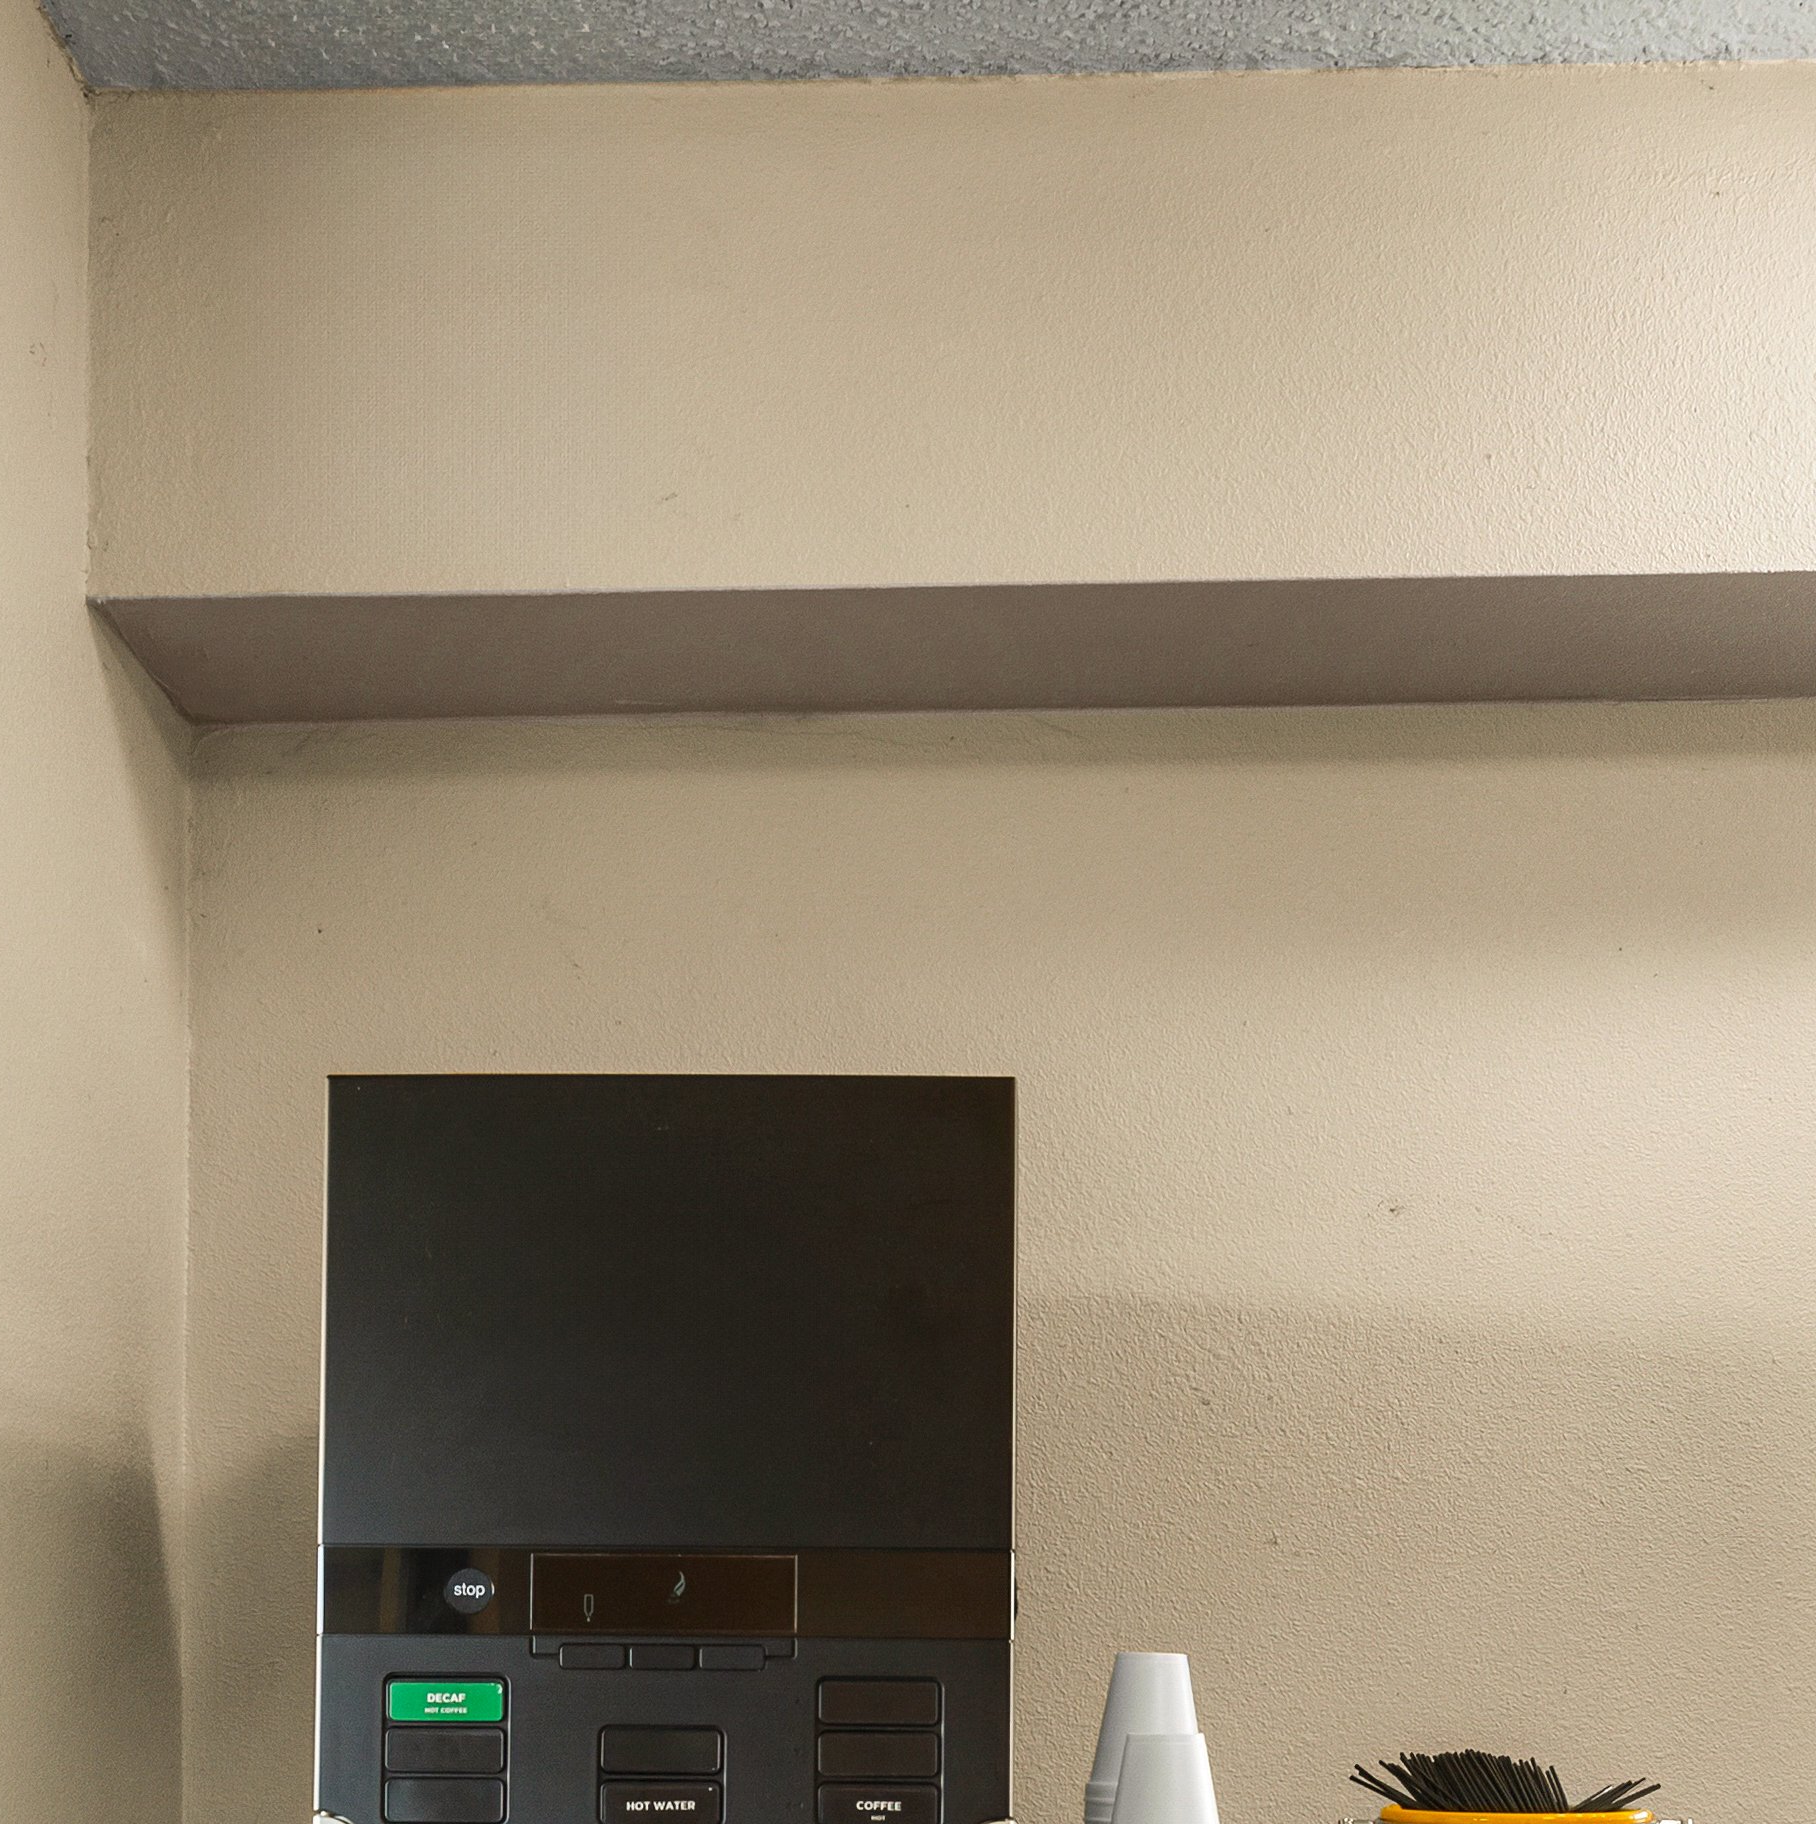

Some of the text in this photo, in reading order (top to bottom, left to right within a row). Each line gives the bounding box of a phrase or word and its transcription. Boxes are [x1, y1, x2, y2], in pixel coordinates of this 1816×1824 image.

[454, 1582, 486, 1599] stop
[426, 1692, 466, 1703] DECAF
[440, 1706, 468, 1714] COFFEE
[626, 1801, 696, 1811] HOT WATER
[856, 1800, 902, 1811] COFFEE
